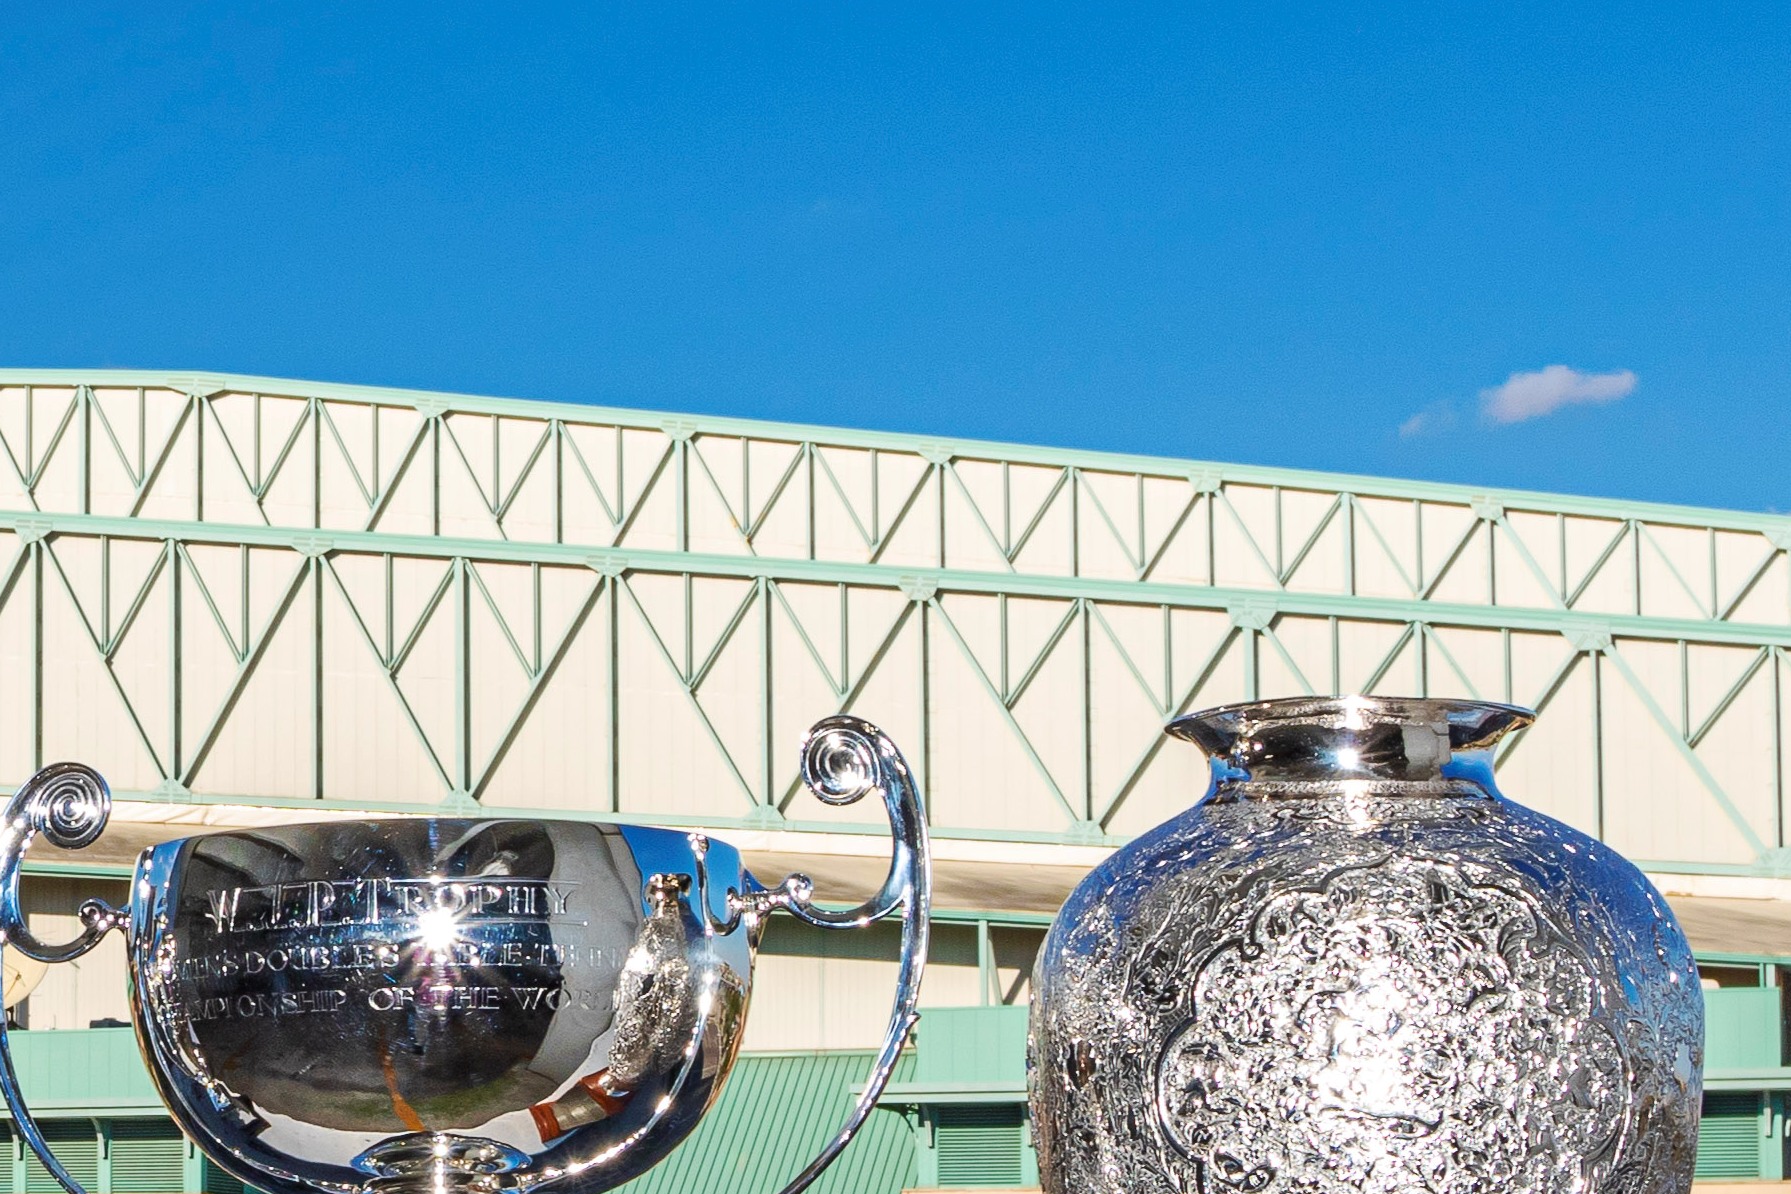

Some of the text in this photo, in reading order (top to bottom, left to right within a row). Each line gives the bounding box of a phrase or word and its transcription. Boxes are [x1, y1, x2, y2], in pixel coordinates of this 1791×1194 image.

[245, 944, 399, 974] DOUBLES
[368, 986, 414, 1011] OF
[429, 985, 500, 1011] THE
